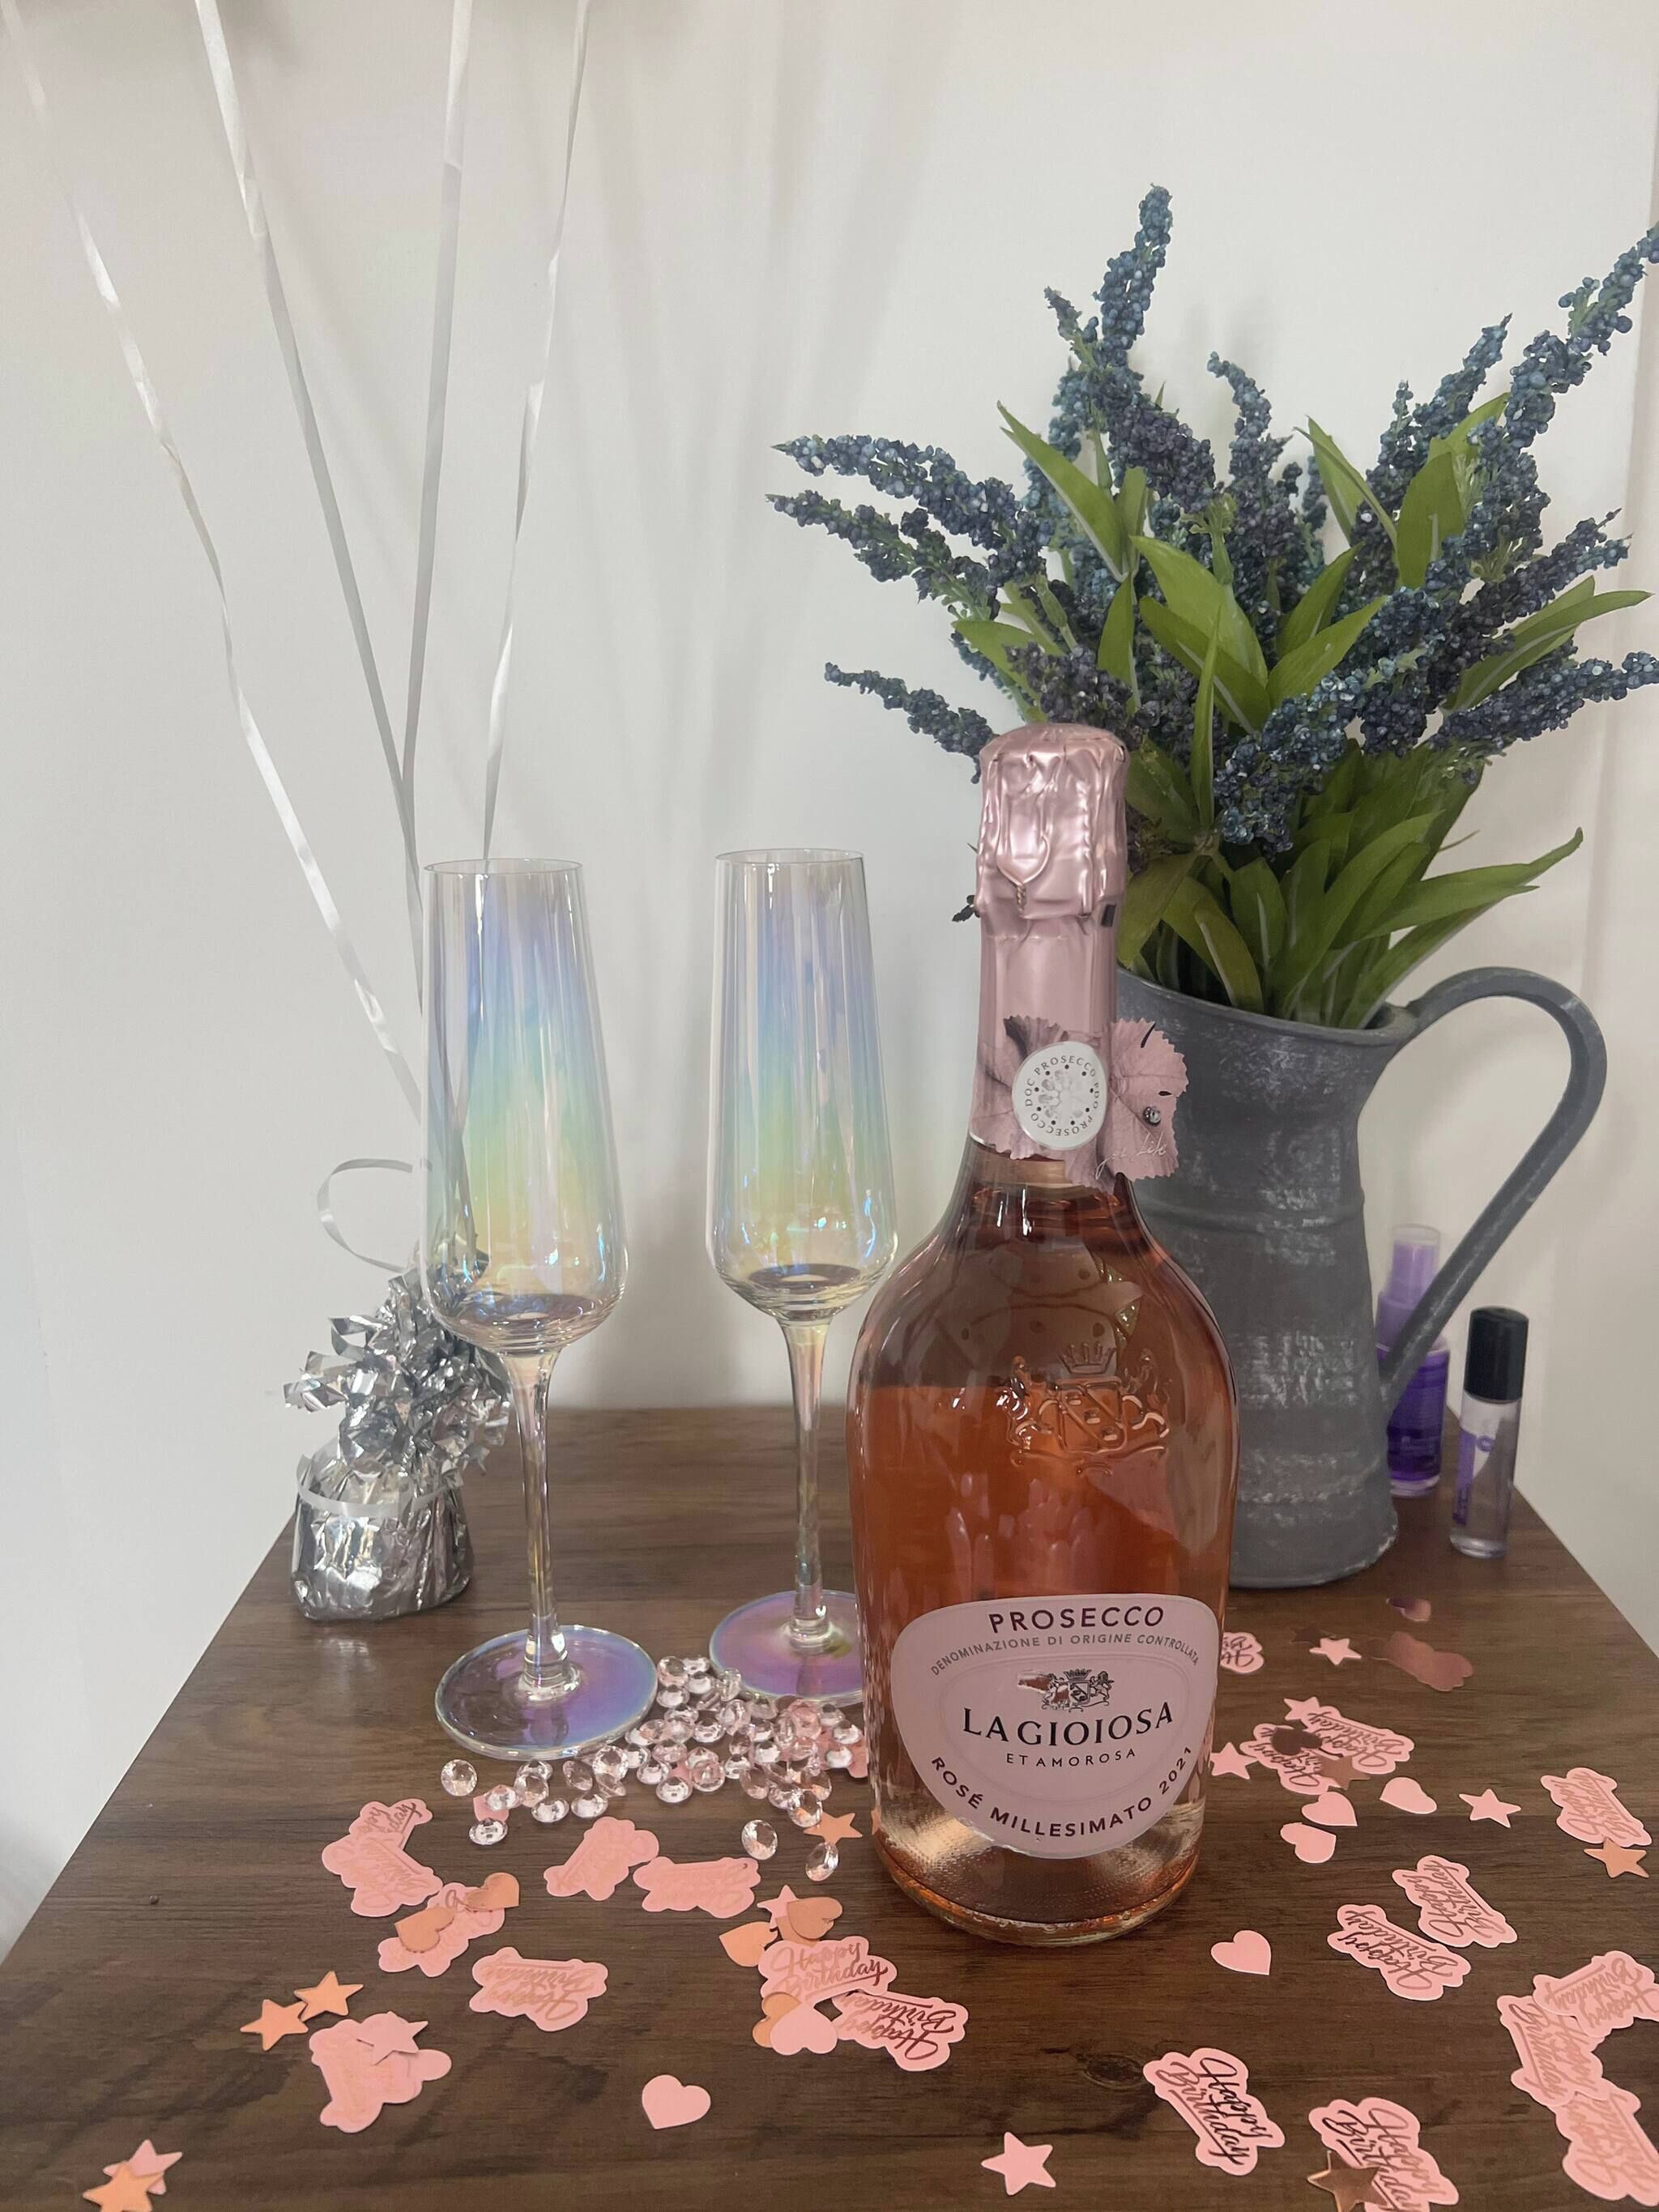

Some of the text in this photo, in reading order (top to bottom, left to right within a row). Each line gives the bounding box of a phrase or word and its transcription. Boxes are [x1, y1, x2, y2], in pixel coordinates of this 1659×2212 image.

[1034, 1055, 1096, 1077] PROSECCO
[1025, 1078, 1035, 1107] DOC
[1030, 1113, 1094, 1136] PROSECCO
[989, 1606, 1164, 1634] PROSECCO
[931, 1636, 1041, 1677] DENOMINAZIONE
[1047, 1635, 1063, 1646] DI
[1070, 1633, 1132, 1645] ORIGINE
[1137, 1634, 1201, 1666] CONTROLLATA
[931, 1745, 1193, 1837] ROSÉ MILLESIMATO 2021
[771, 1942, 861, 1971] Happy
[1337, 1931, 1432, 1990] Happy
[1345, 1910, 1458, 1977] Birthday
[1156, 2061, 1250, 2165] Birthday
[1200, 2057, 1273, 2139] Happy
[1369, 2108, 1446, 2197] Happy
